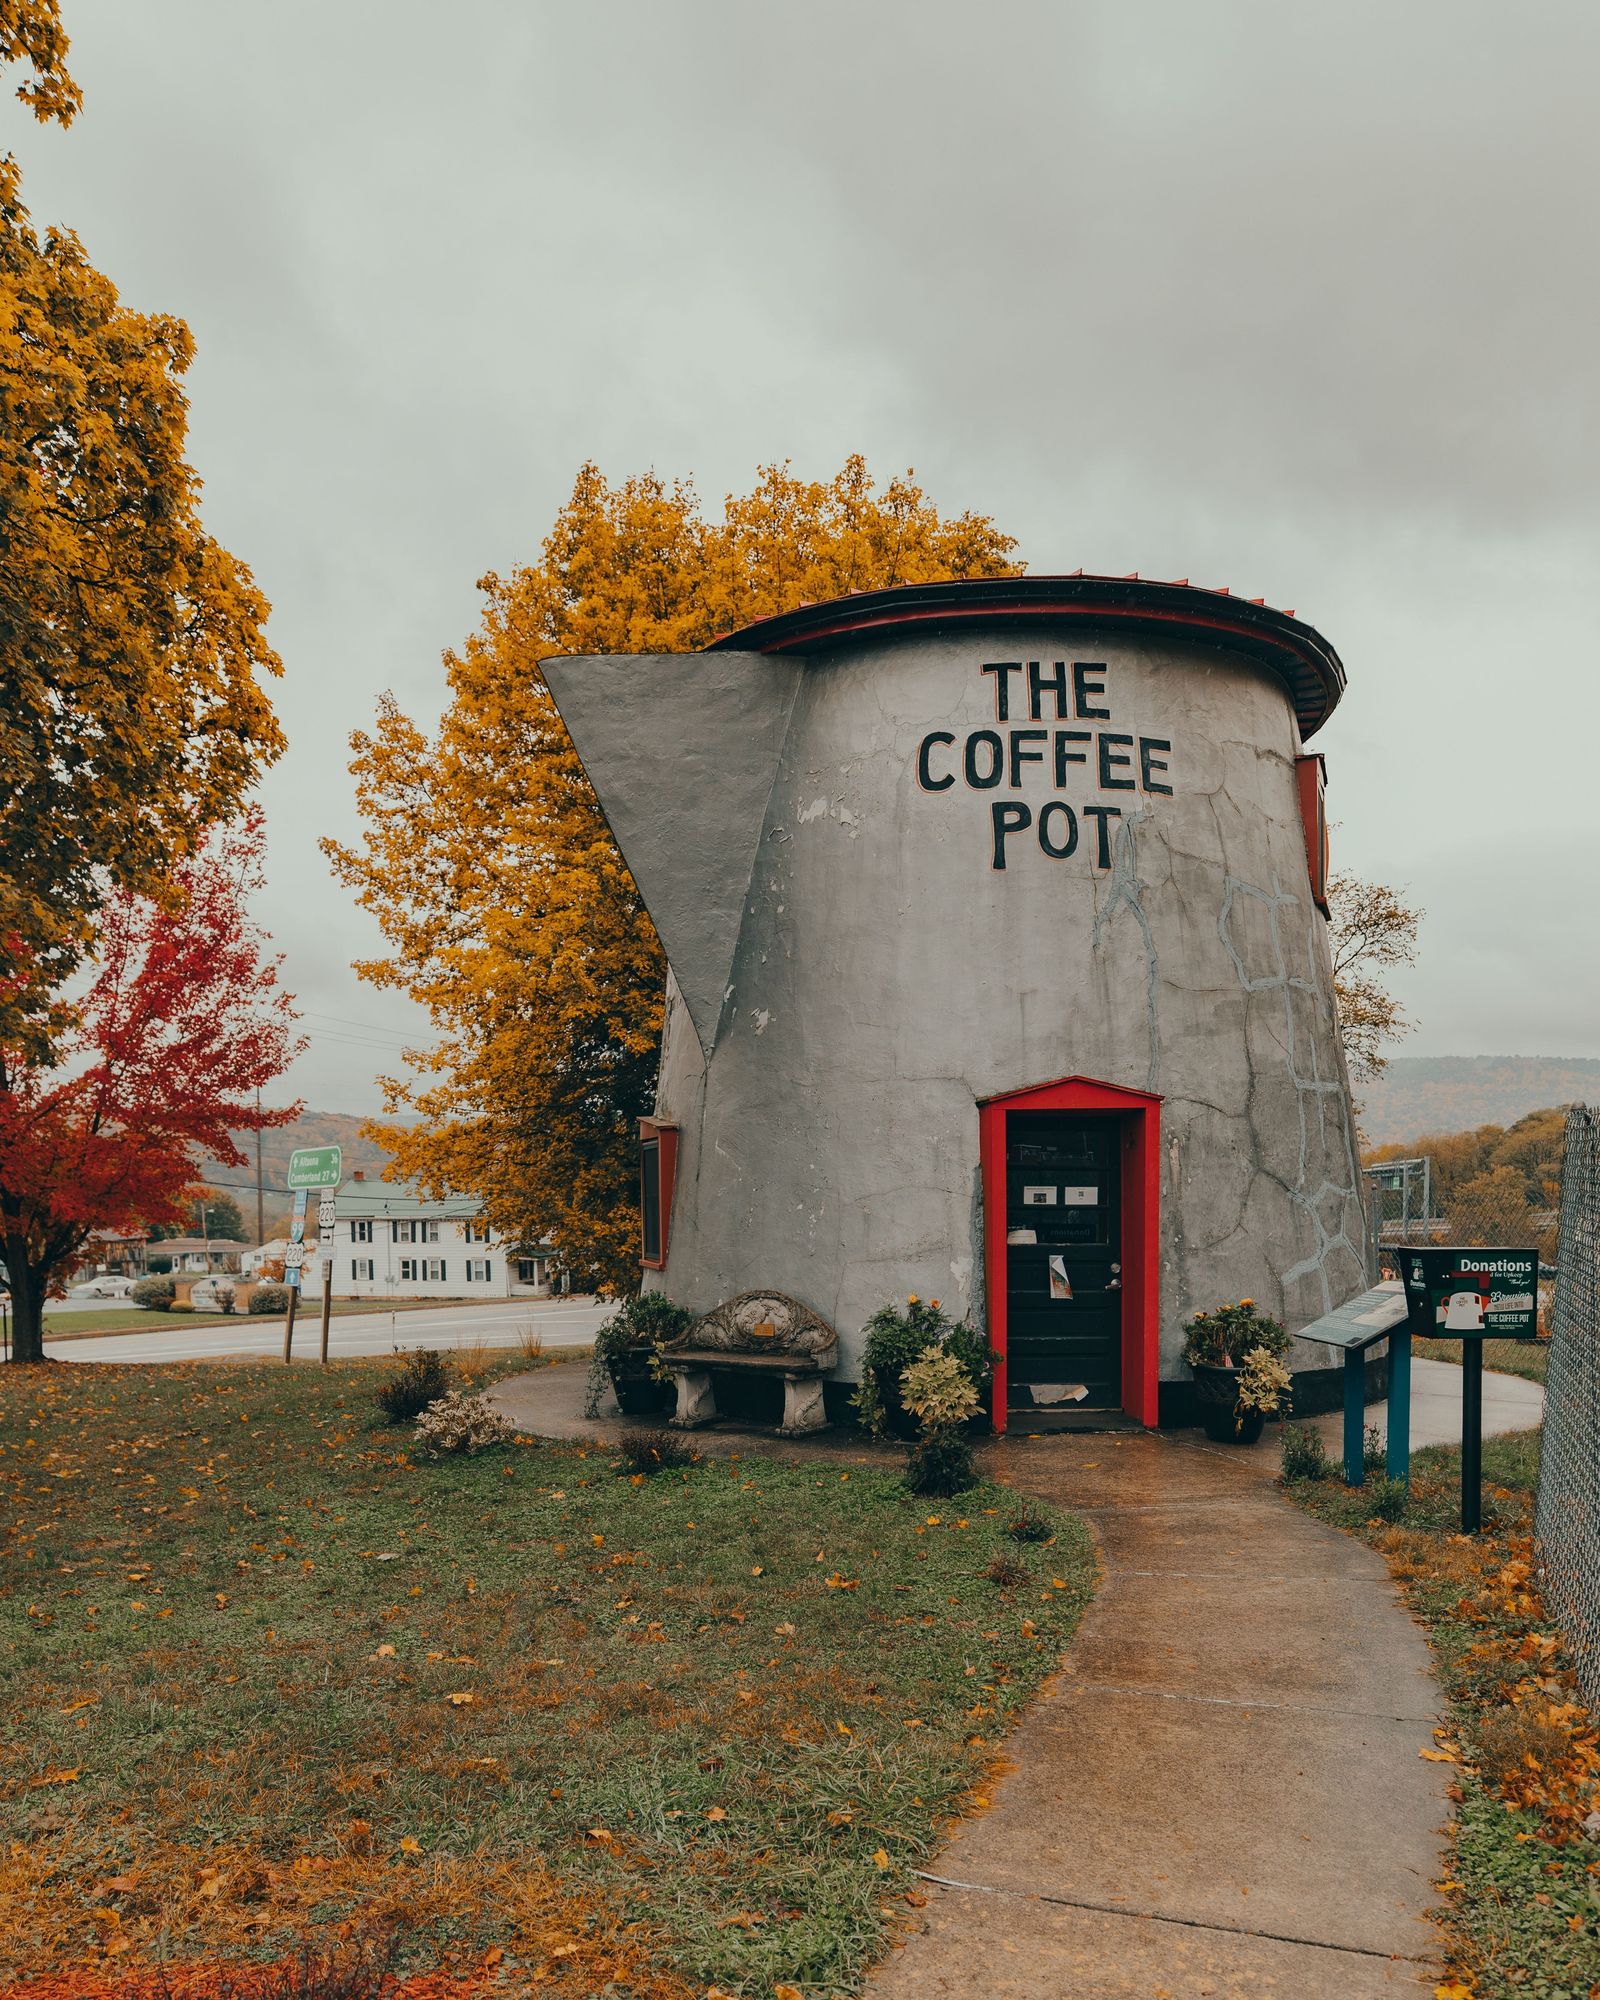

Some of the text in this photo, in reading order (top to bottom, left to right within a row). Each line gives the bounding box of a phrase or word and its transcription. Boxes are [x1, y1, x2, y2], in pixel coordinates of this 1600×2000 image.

[980, 661, 1110, 723] THE
[916, 729, 1174, 799] COFFEE
[991, 801, 1121, 871] POT
[322, 1170, 330, 1181] 27
[320, 1207, 334, 1222] 220
[292, 1223, 304, 1236] 99
[287, 1248, 302, 1262] 220
[1460, 1259, 1532, 1272] Donations
[1490, 1291, 1532, 1304] Brewing
[1488, 1313, 1530, 1323] THE COFFEE POT
